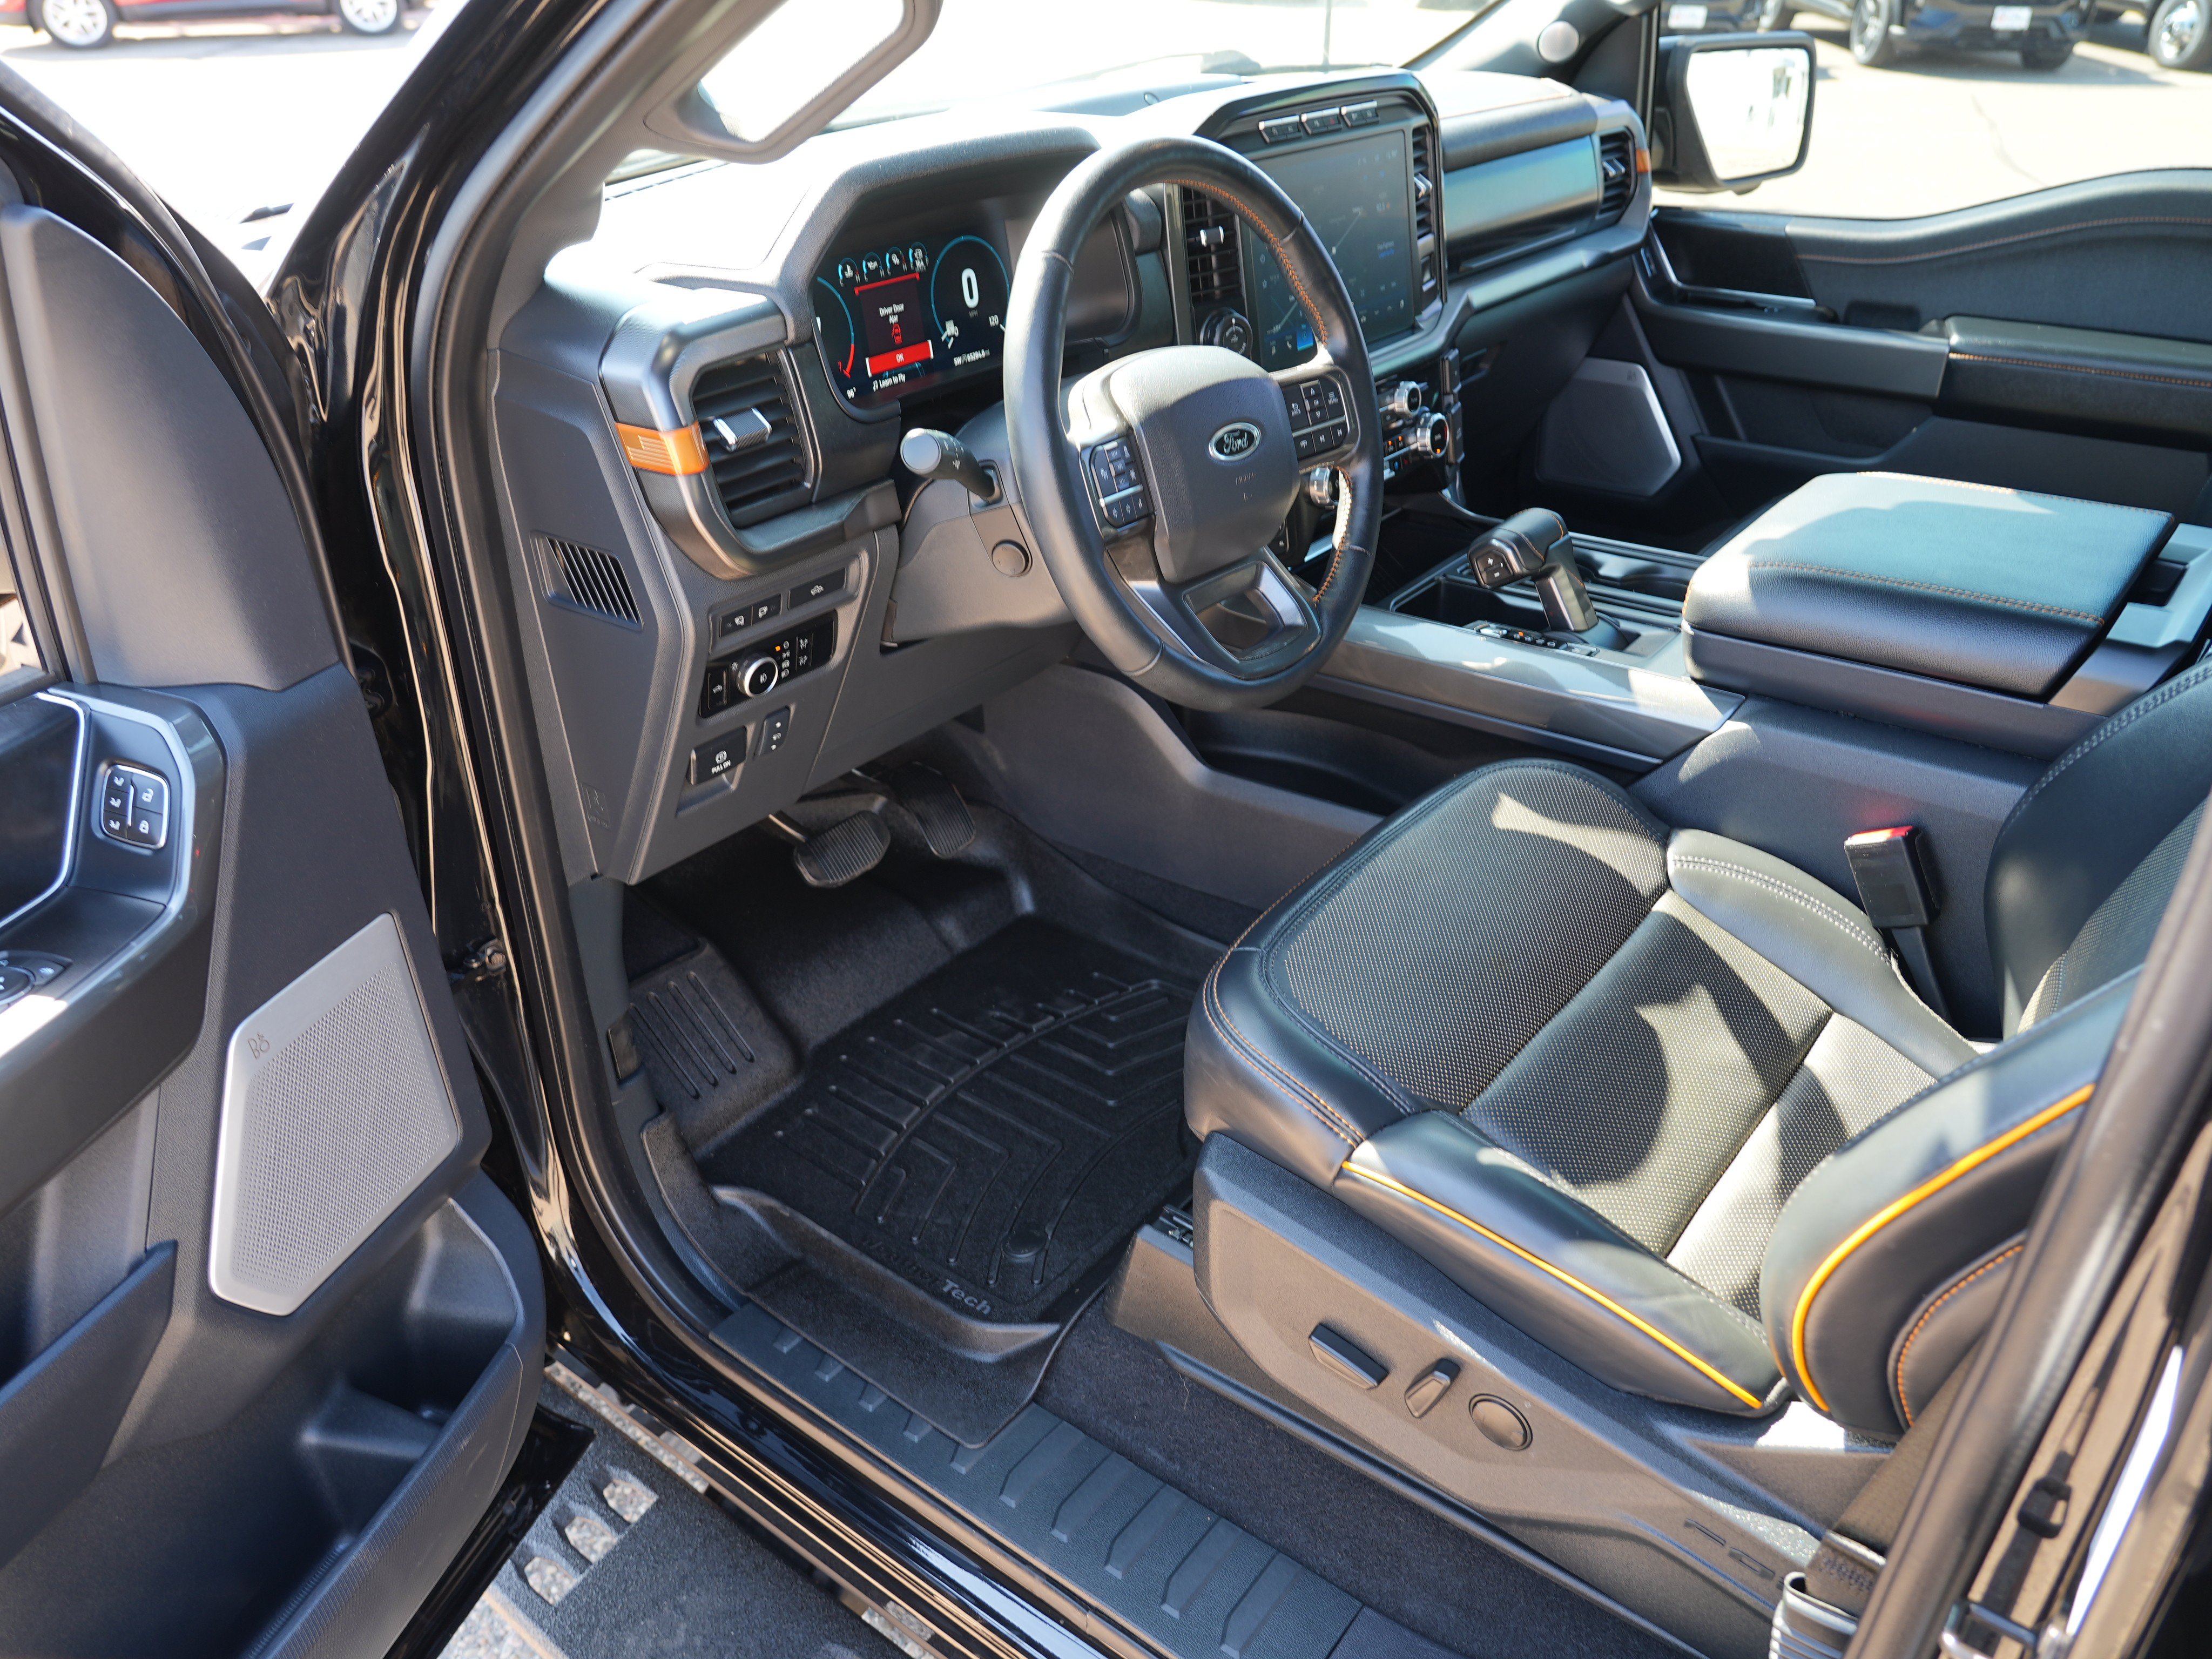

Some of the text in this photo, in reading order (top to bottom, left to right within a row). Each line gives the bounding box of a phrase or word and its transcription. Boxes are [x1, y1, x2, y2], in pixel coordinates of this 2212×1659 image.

[962, 268, 979, 308] 0
[879, 303, 904, 317] Driver Door
[889, 314, 898, 325] Ajar
[989, 315, 999, 327] 120
[896, 353, 905, 363] OK
[879, 377, 893, 389] Learn
[892, 376, 899, 385] to
[1223, 430, 1249, 454] Ford
[711, 759, 731, 775] PULL ON
